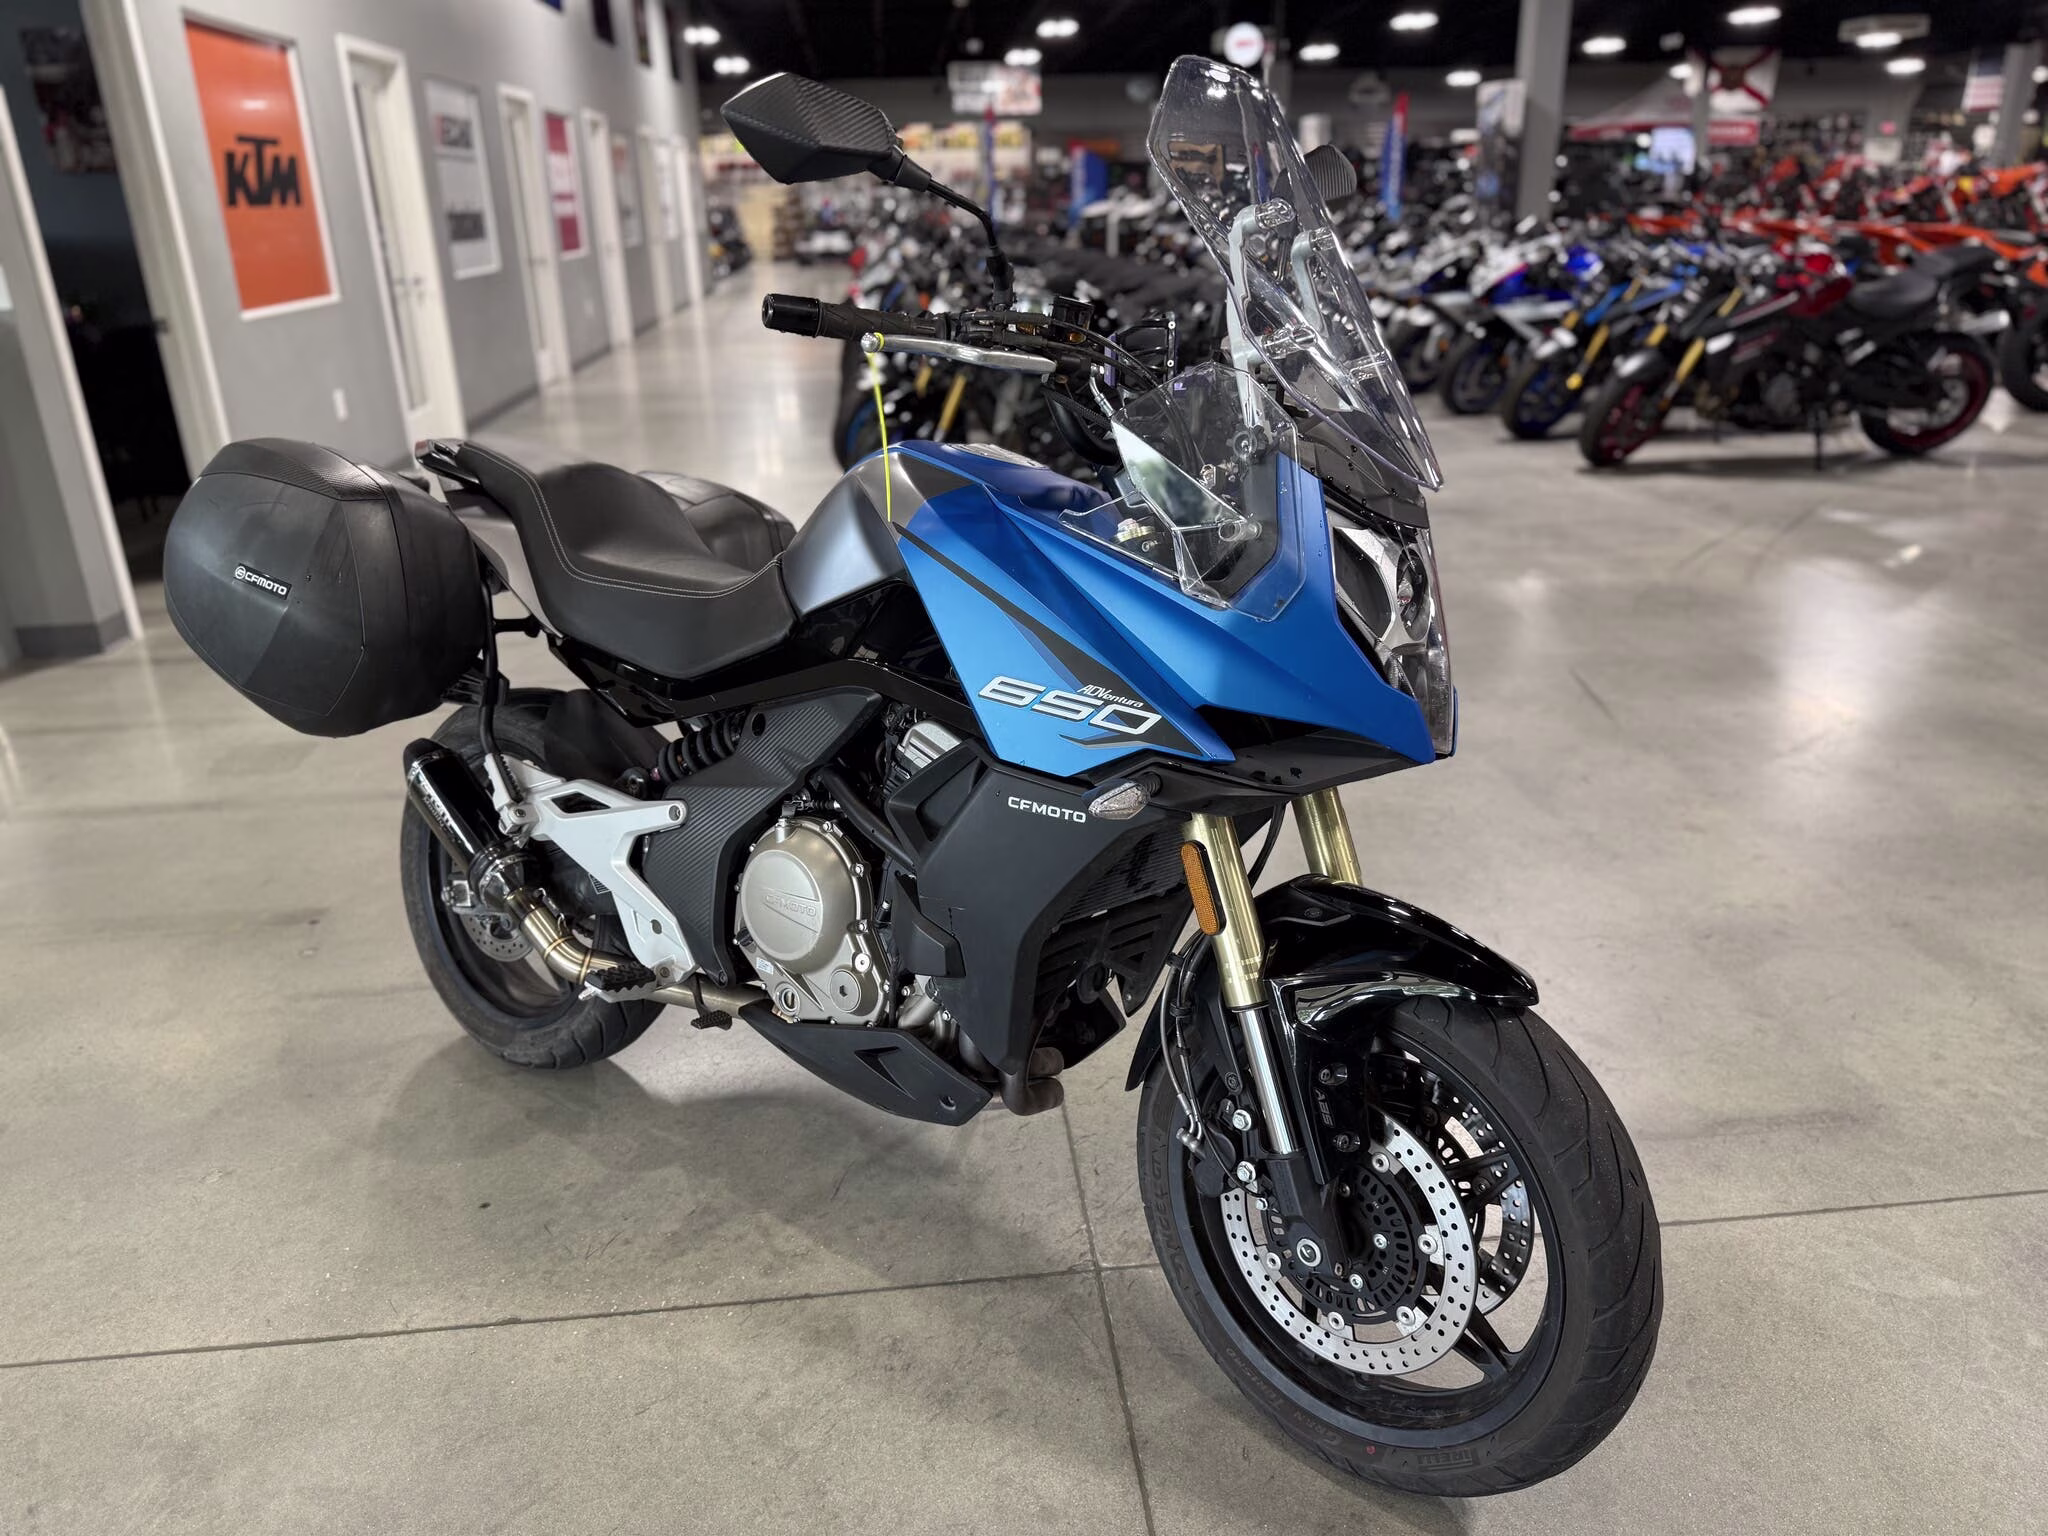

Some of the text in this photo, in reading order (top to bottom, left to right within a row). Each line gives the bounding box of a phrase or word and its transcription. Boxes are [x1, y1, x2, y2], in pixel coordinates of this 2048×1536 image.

[225, 135, 302, 207] KTM
[245, 572, 288, 595] CFMOTO
[978, 675, 1162, 735] 650
[1077, 684, 1144, 708] ADVentura
[1007, 796, 1087, 824] CFMOTO
[764, 894, 817, 917] CFMOTO
